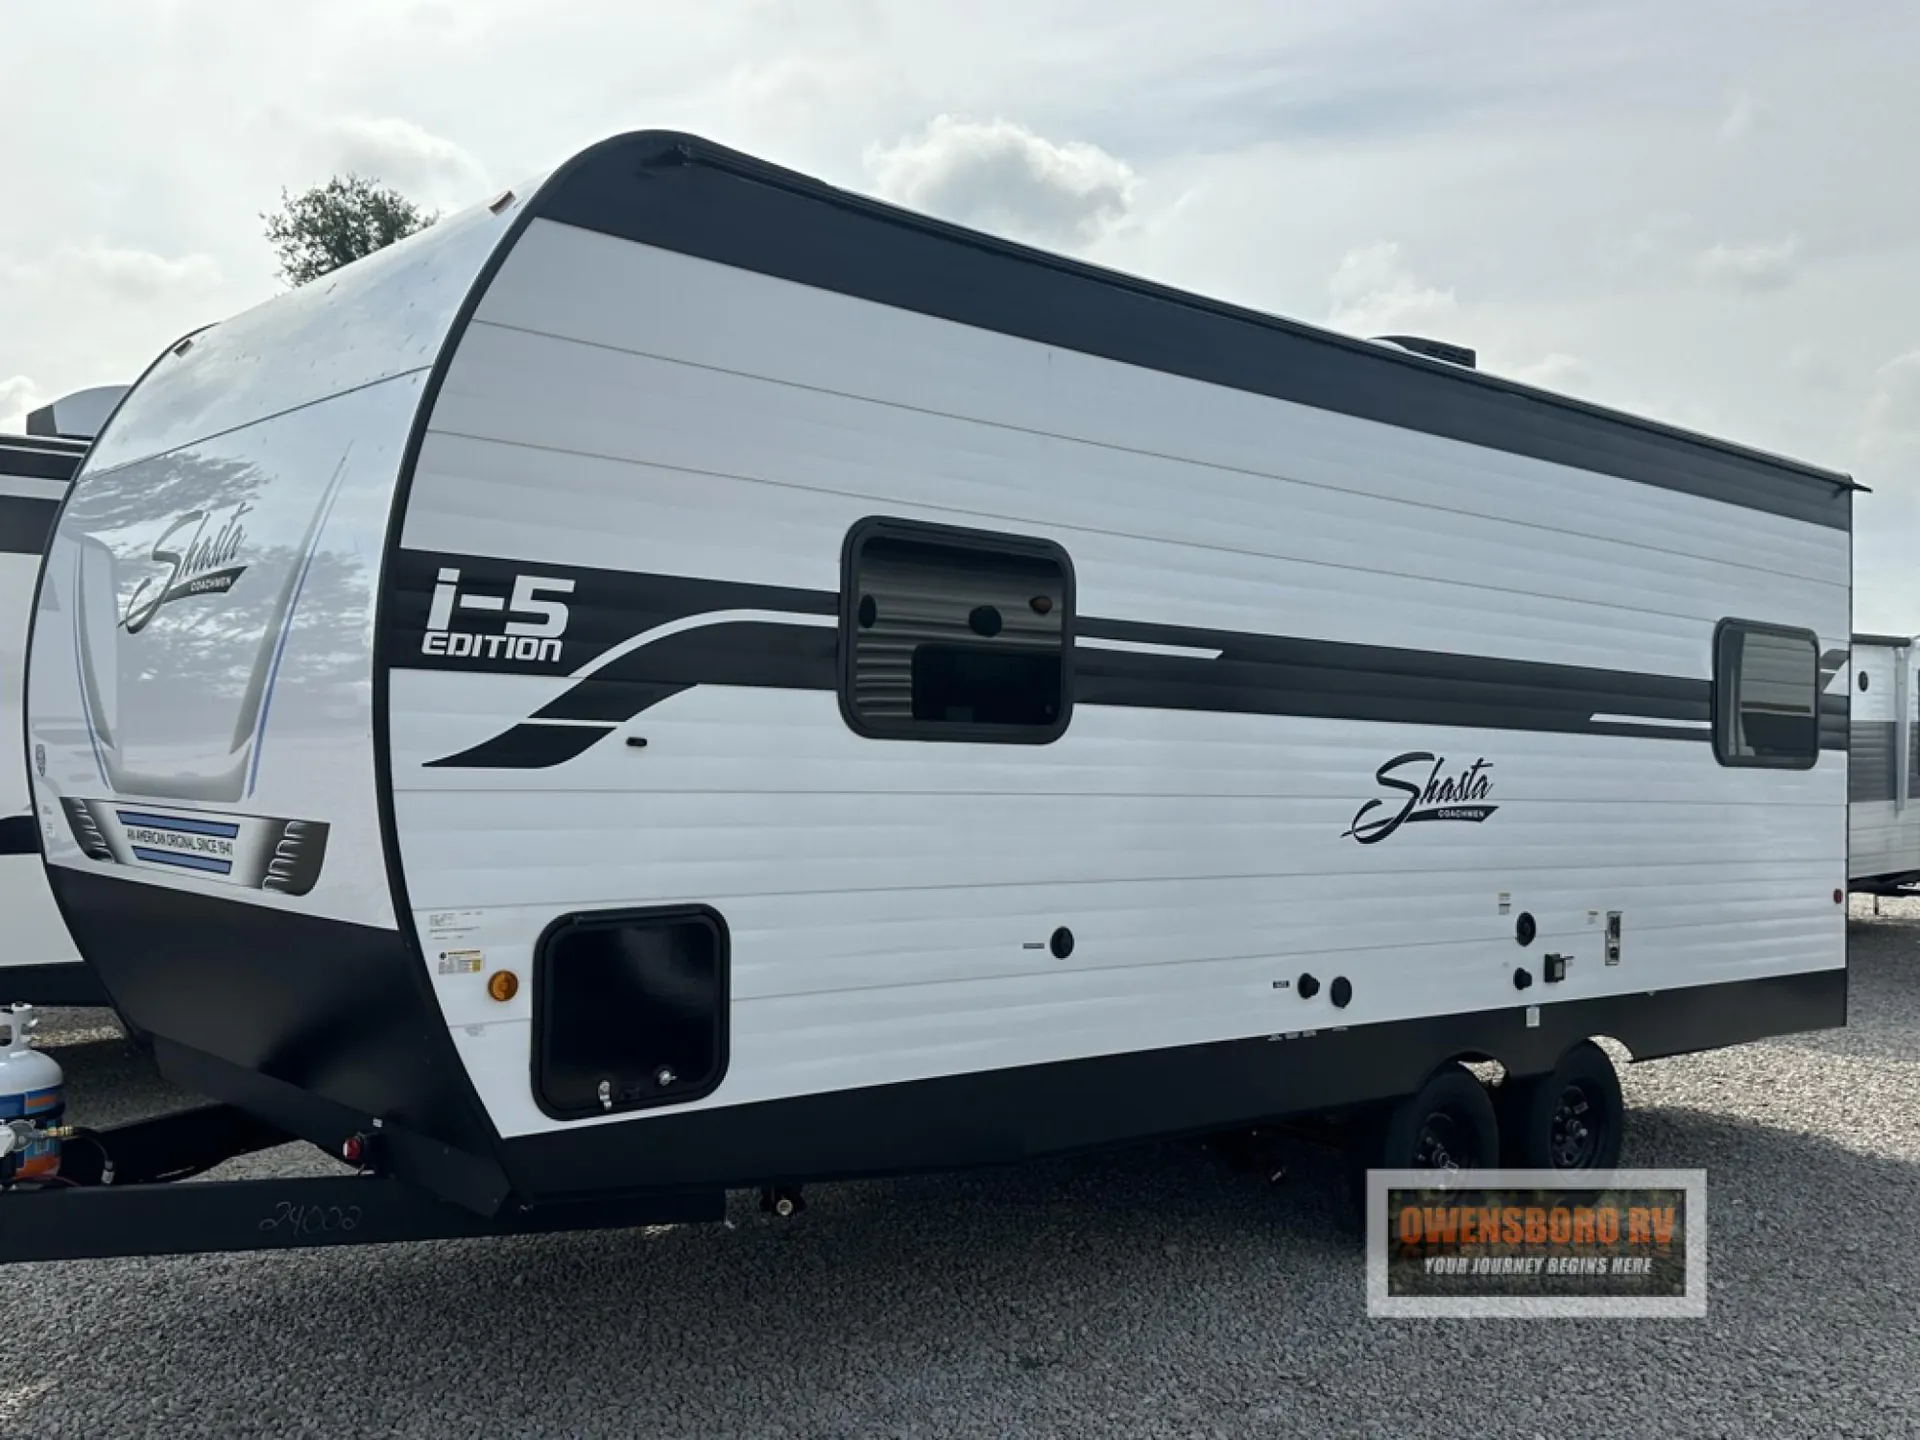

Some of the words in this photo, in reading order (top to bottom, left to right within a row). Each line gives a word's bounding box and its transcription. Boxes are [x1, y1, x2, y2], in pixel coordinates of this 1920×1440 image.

[116, 501, 253, 634] Shasta
[426, 567, 576, 638] i-5
[421, 631, 563, 662] EDITION
[1340, 751, 1494, 844] Shasta
[1437, 809, 1486, 819] COACHMEN
[136, 829, 166, 845] AMERICAN
[166, 833, 197, 850] ORIGINAL
[196, 837, 218, 853] SINCE
